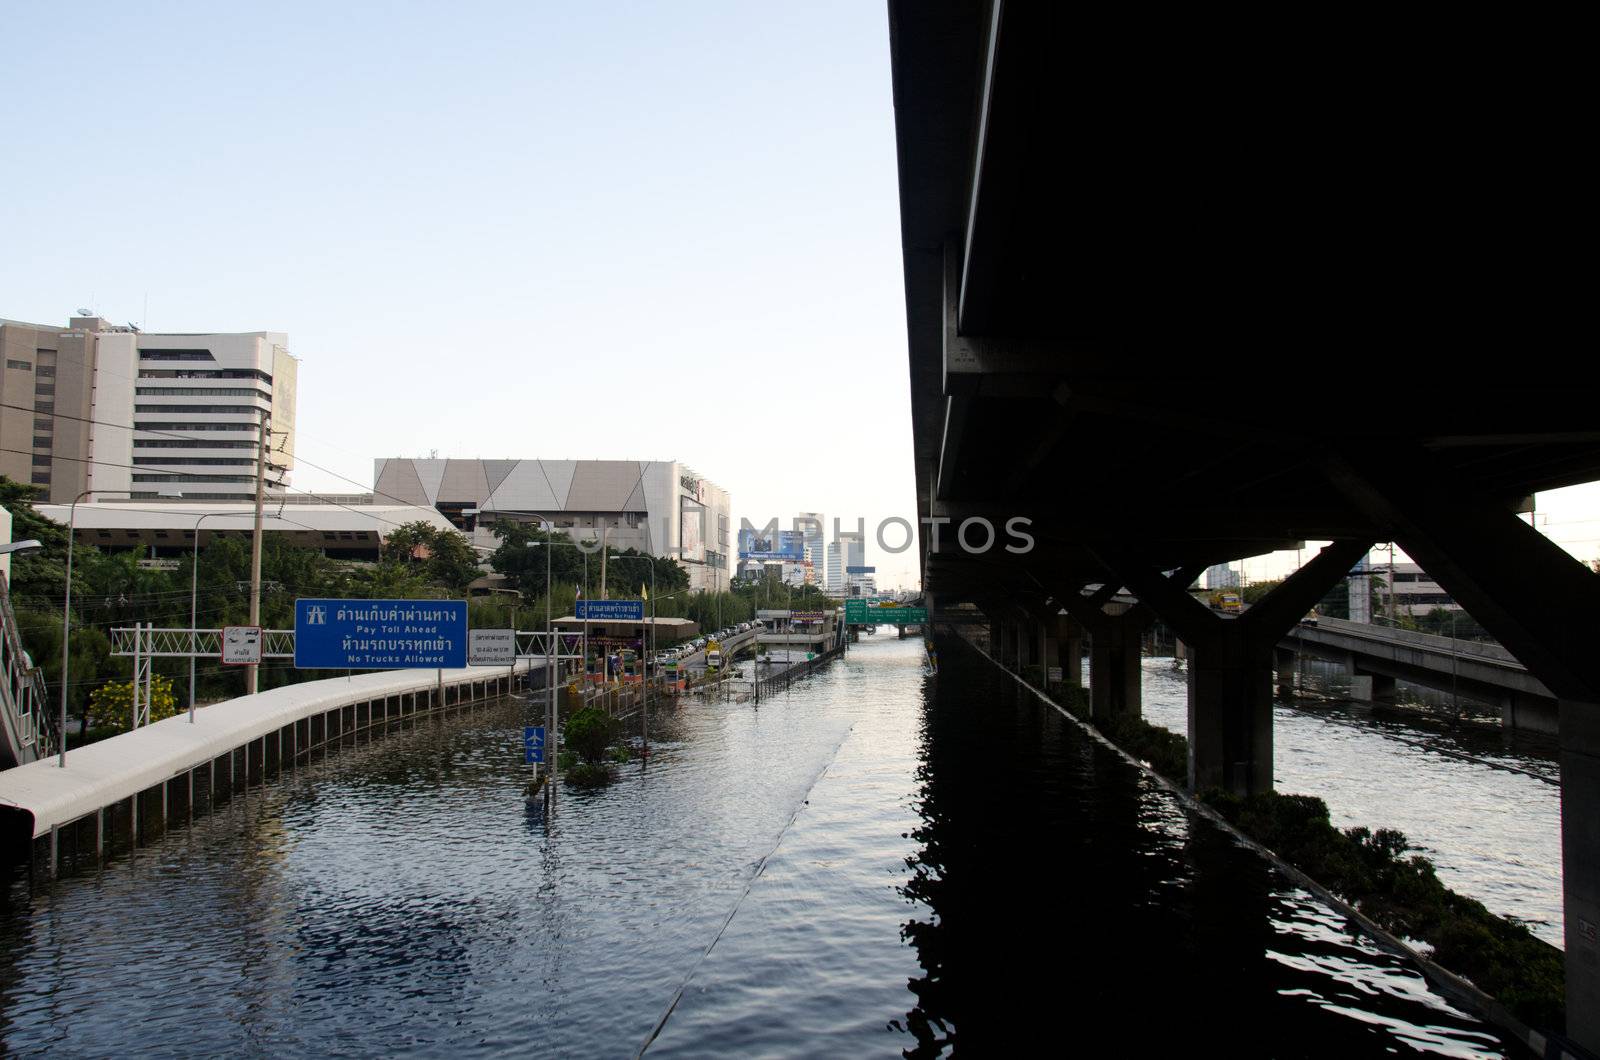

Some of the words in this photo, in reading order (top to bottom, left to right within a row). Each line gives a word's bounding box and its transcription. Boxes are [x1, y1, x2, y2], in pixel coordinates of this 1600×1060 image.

[336, 604, 457, 623] ด่านเก็บค่าผ่านทาง
[356, 625, 376, 636] Pay
[381, 625, 400, 634] Toll
[404, 625, 437, 634] Ahead
[342, 635, 452, 655] ห้ามรถบรรทุกเข้า
[347, 654, 361, 664] No
[365, 654, 400, 664] Trucks
[404, 654, 444, 664] Allowed
